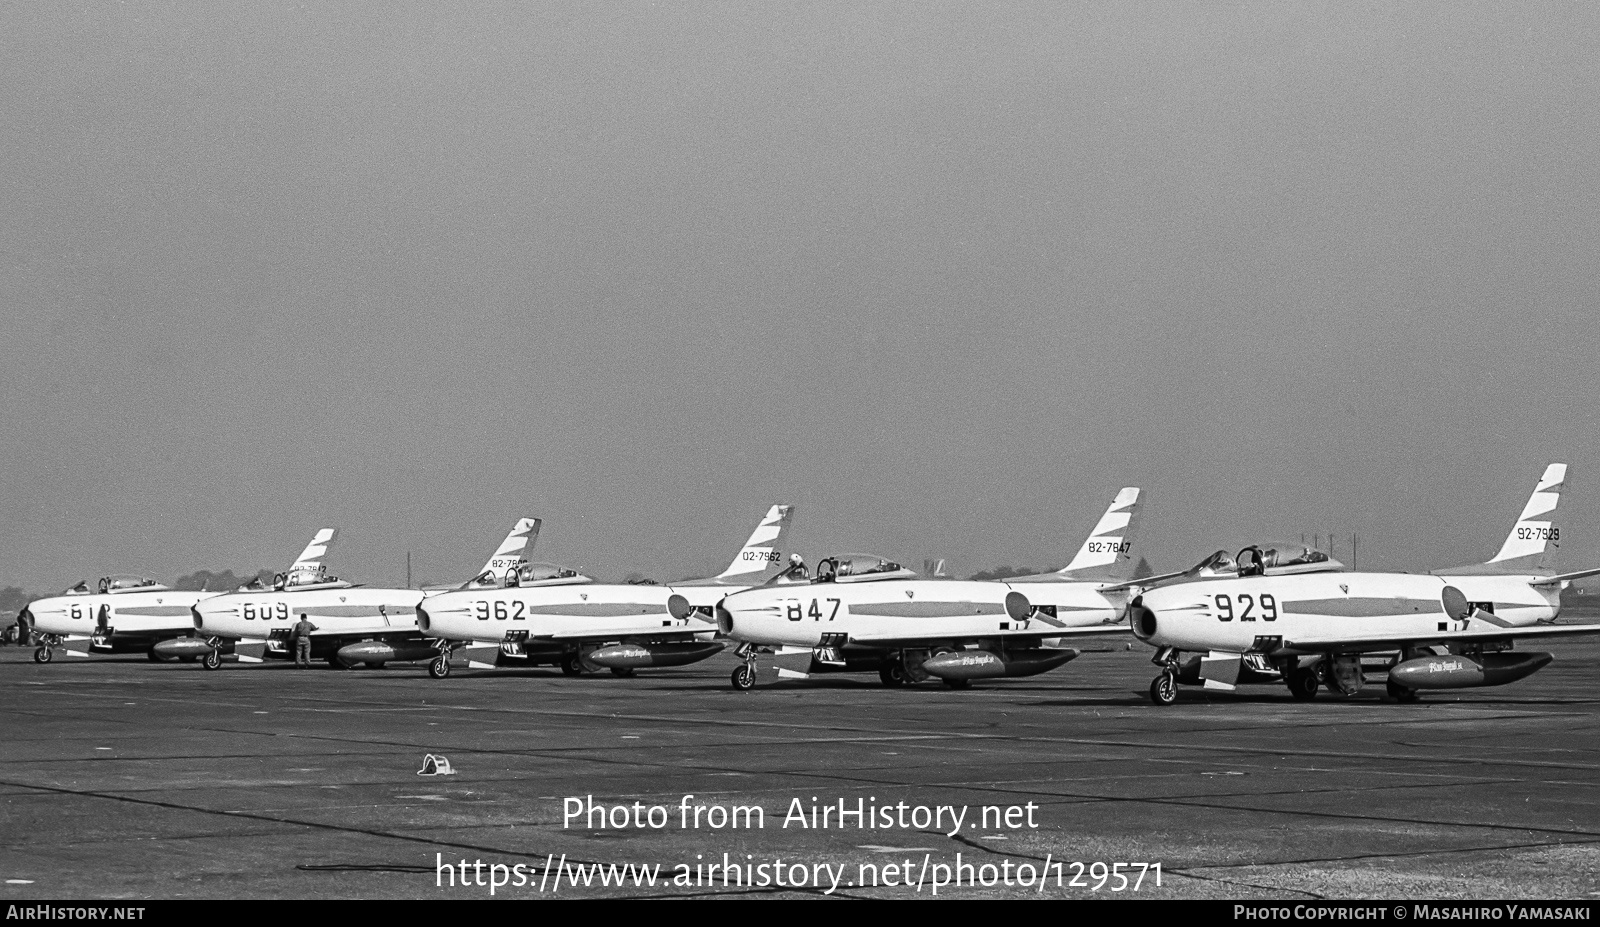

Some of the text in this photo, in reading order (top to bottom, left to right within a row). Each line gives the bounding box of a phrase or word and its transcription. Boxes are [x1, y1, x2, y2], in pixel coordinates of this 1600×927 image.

[1517, 527, 1560, 541] 92-7929
[742, 551, 782, 562] 02-7962
[1088, 541, 1132, 554] 82-7847
[243, 602, 289, 621] 809
[474, 600, 525, 621] 962
[786, 598, 841, 622] 847
[1214, 593, 1278, 623] 929
